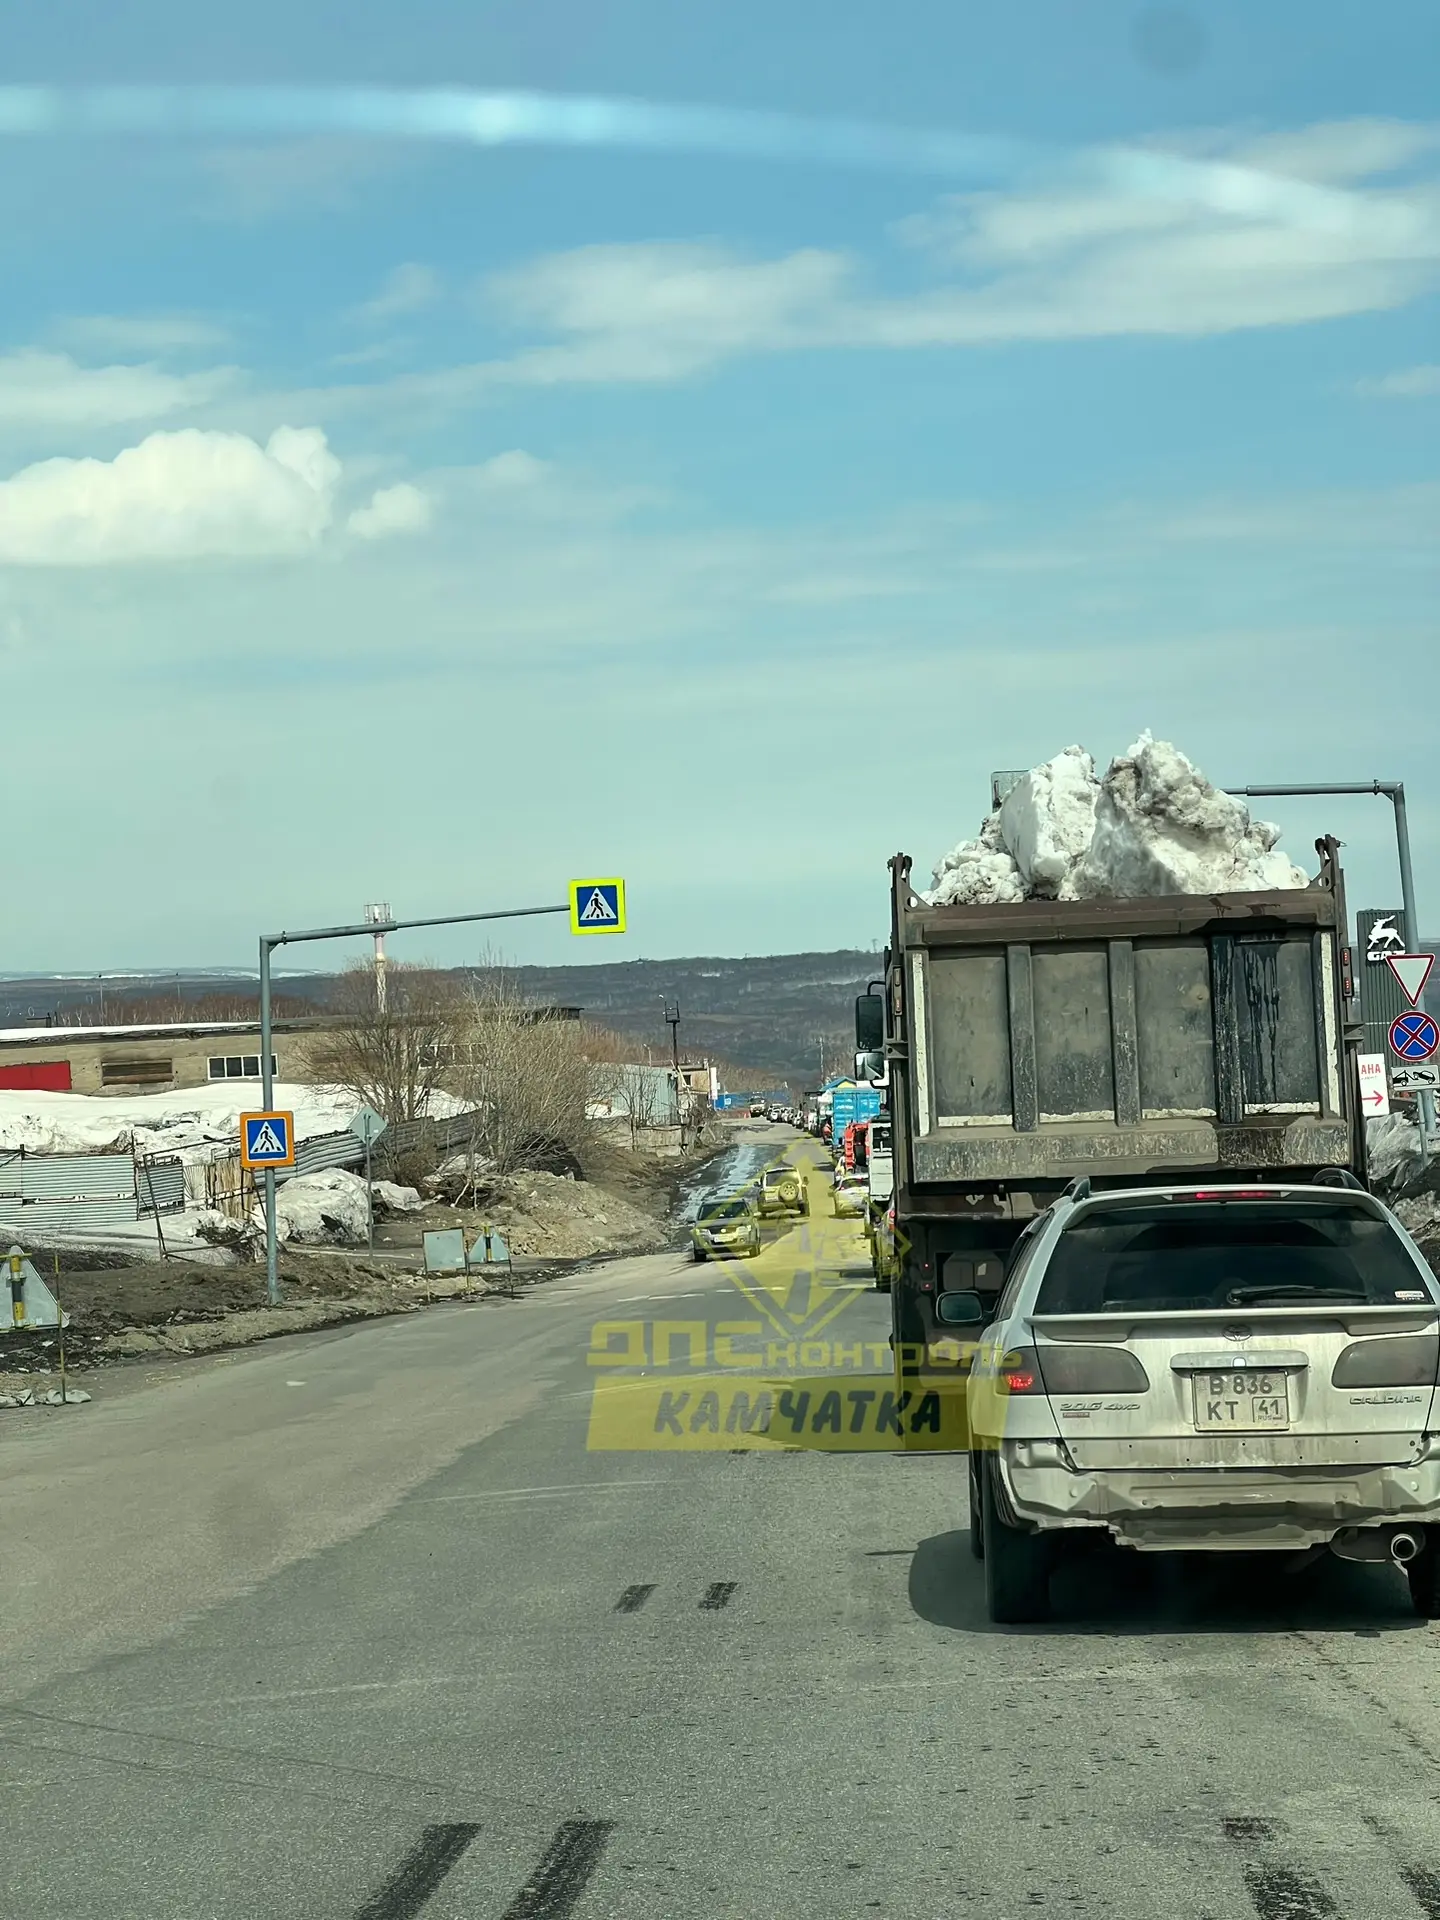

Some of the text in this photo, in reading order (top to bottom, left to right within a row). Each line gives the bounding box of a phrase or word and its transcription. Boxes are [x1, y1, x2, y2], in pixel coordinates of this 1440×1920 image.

[1233, 1375, 1273, 1395] 836
[1207, 1399, 1279, 1421] КТ 41
